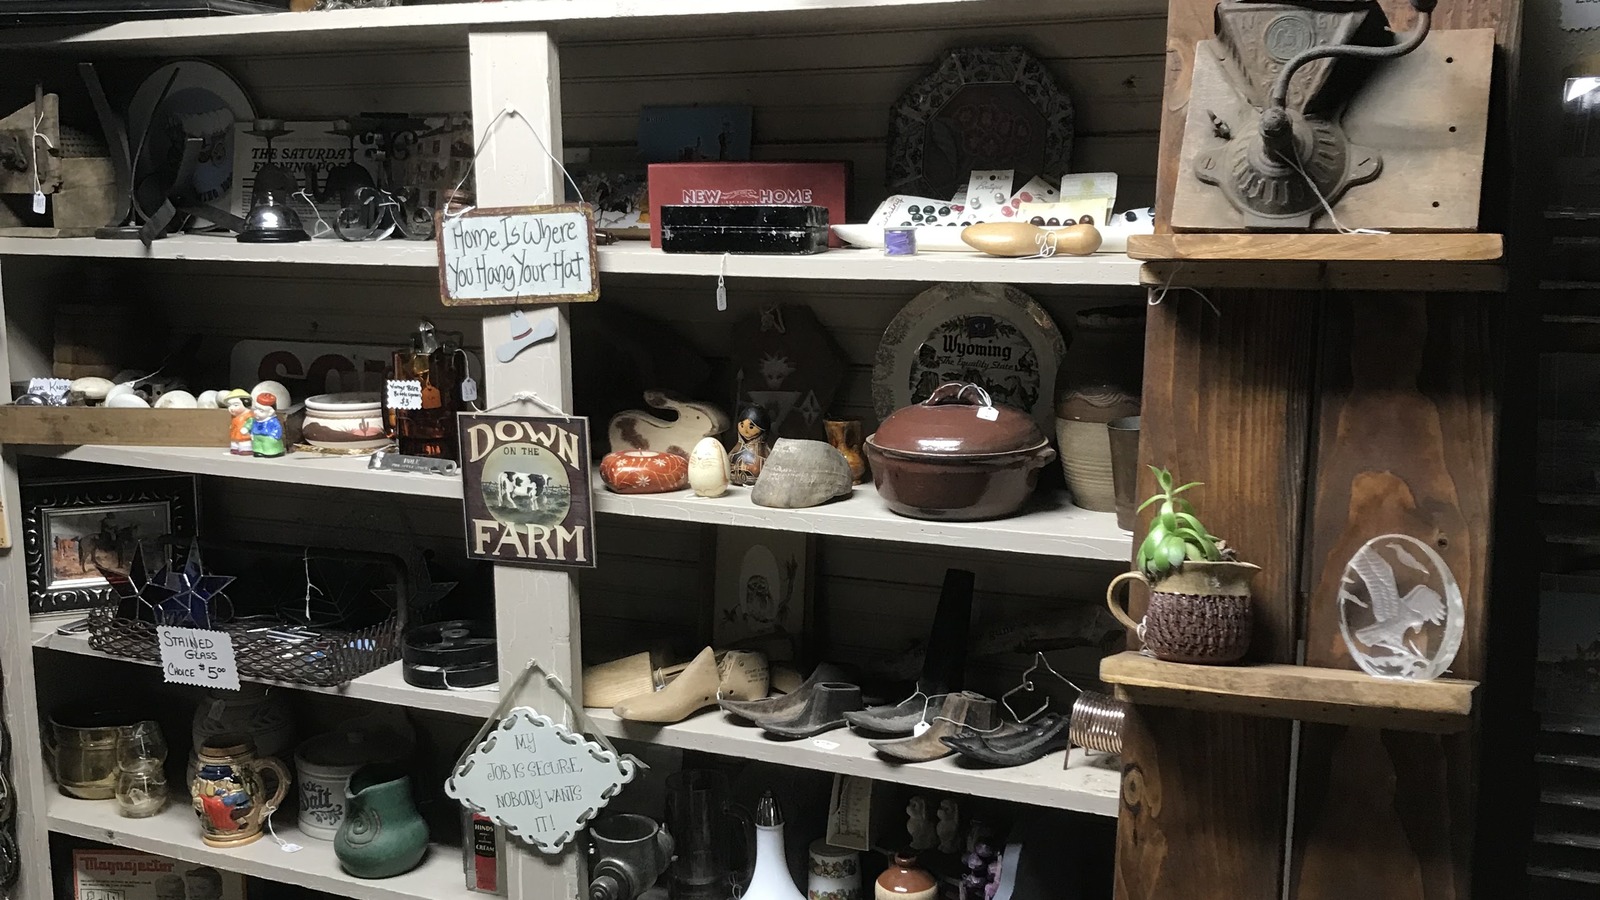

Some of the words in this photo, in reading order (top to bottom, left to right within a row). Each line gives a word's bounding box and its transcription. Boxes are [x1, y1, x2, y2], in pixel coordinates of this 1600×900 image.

[252, 148, 278, 159] THE
[281, 148, 358, 161] SATURDAY
[682, 189, 721, 204] NEW
[759, 189, 813, 204] HOME
[452, 220, 500, 257] Home
[500, 216, 520, 253] Is
[523, 218, 578, 252] Where
[449, 257, 474, 292] You
[475, 254, 516, 292] Hang
[512, 249, 551, 286] Your
[553, 250, 584, 288] Hat
[942, 335, 1012, 361] Wyoming
[938, 355, 955, 366] The
[957, 358, 990, 371] Equality
[992, 361, 1014, 370] State
[467, 420, 580, 471] DOWN
[503, 447, 517, 456] ON
[521, 447, 540, 456] THE
[472, 519, 587, 562] FARM
[164, 631, 214, 649] STAINED
[184, 650, 218, 660] GLASS
[514, 733, 536, 753] MY
[487, 762, 512, 781] JOB
[513, 763, 525, 778] IS
[527, 757, 584, 777] SECURE,
[496, 788, 543, 809] NOBODY
[545, 785, 583, 802] WANTS
[535, 815, 556, 832] IT!
[475, 844, 495, 852] CREAM
[80, 856, 175, 875] Magnajector
